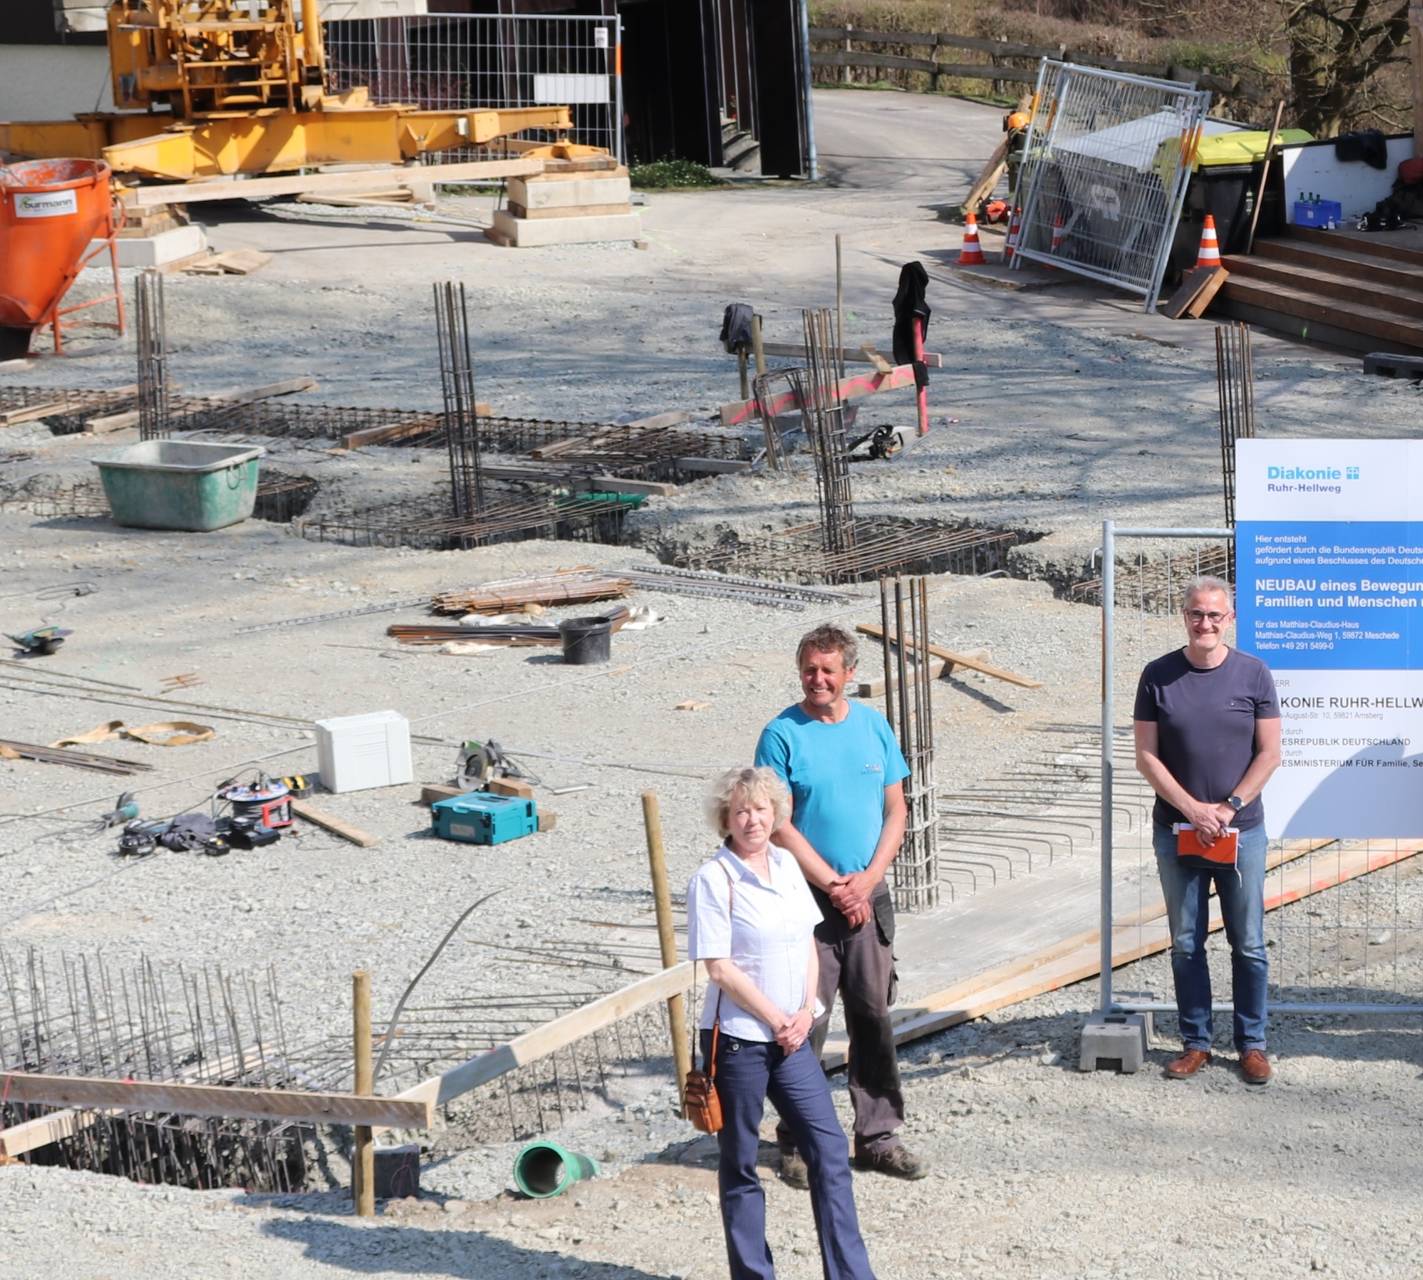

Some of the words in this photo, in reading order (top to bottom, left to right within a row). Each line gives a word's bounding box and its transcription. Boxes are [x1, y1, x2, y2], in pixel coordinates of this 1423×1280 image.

[1267, 466, 1342, 480] Diakonie
[1267, 483, 1342, 494] Ruhr-Hellweg
[1255, 535, 1273, 543] Hier
[1274, 535, 1307, 544] entsteht
[1255, 545, 1292, 555] gefördert
[1294, 545, 1317, 554] durch
[1318, 545, 1331, 554] die
[1333, 545, 1396, 555] Bundesrepublik
[1255, 556, 1291, 566] aufgrund
[1293, 557, 1315, 565] eines
[1317, 556, 1369, 565] Beschlusses
[1370, 556, 1386, 565] des
[1255, 579, 1317, 591] NEUBAU
[1320, 579, 1357, 591] eines
[1255, 595, 1313, 607] Familien
[1317, 595, 1344, 607] und
[1347, 595, 1417, 607] Menschen
[1255, 620, 1265, 629] für
[1265, 620, 1279, 629] das
[1280, 620, 1360, 629] Matthias-Claudius-Haus
[1255, 631, 1333, 641] Matthias-Claudius-Weg
[1365, 631, 1400, 640] Meschede
[1255, 642, 1280, 650] Telefon
[1281, 642, 1295, 650] +49
[1280, 697, 1325, 708] KONIE
[1281, 738, 1340, 746] ESREPUBLIK
[1342, 738, 1411, 746] DEUTSCHLAND
[1281, 759, 1353, 768] ESMINISTERIUM
[1356, 758, 1374, 768] FÜR
[1377, 759, 1411, 769] Familie,
